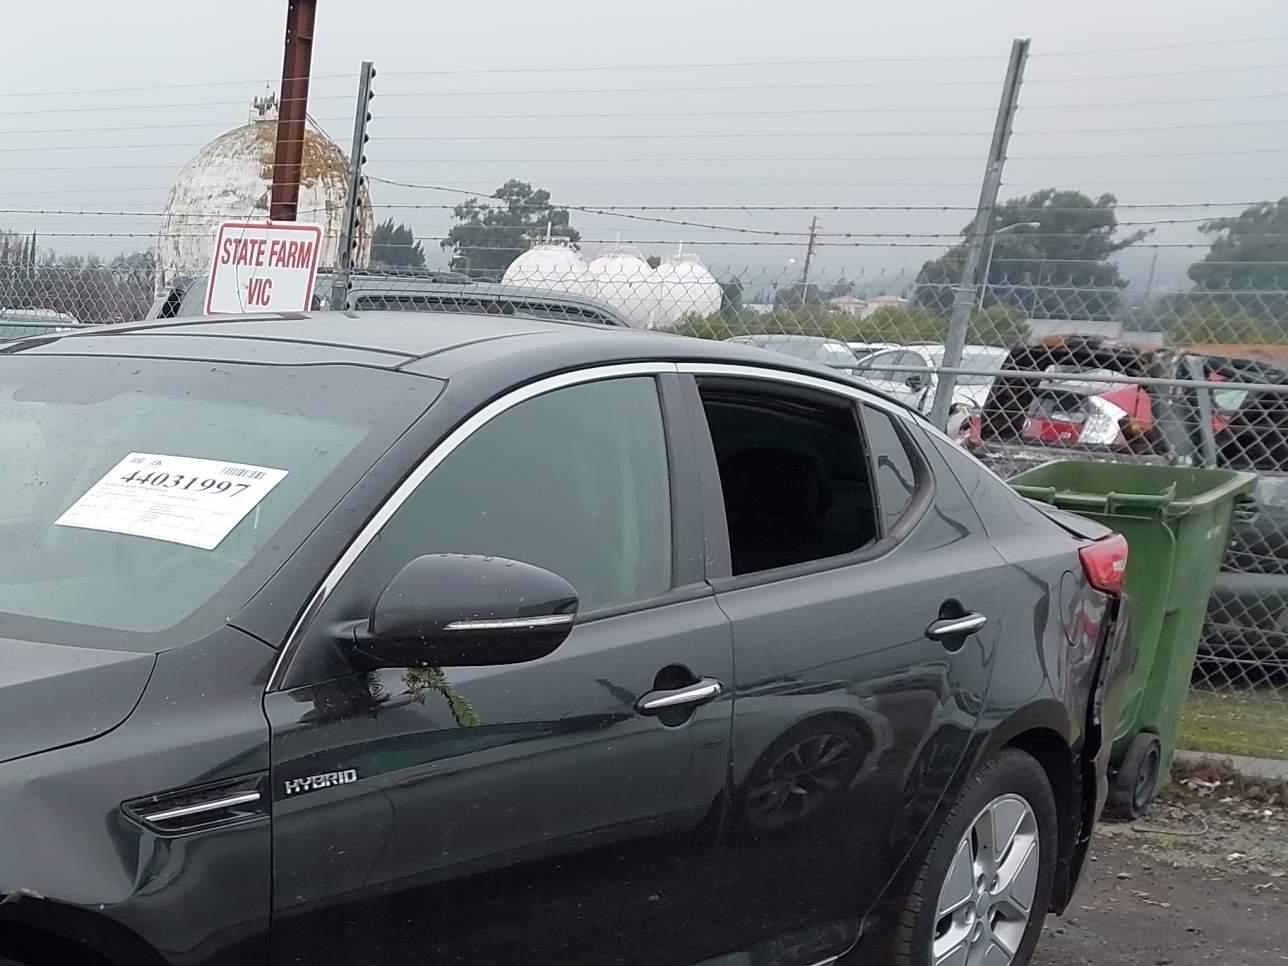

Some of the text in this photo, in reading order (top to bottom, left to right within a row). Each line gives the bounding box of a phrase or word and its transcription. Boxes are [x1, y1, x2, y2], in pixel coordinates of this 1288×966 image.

[221, 237, 313, 269] STATE FARM
[247, 277, 273, 306] VIC
[120, 469, 252, 498] 44031997
[284, 769, 357, 794] HYBRID
